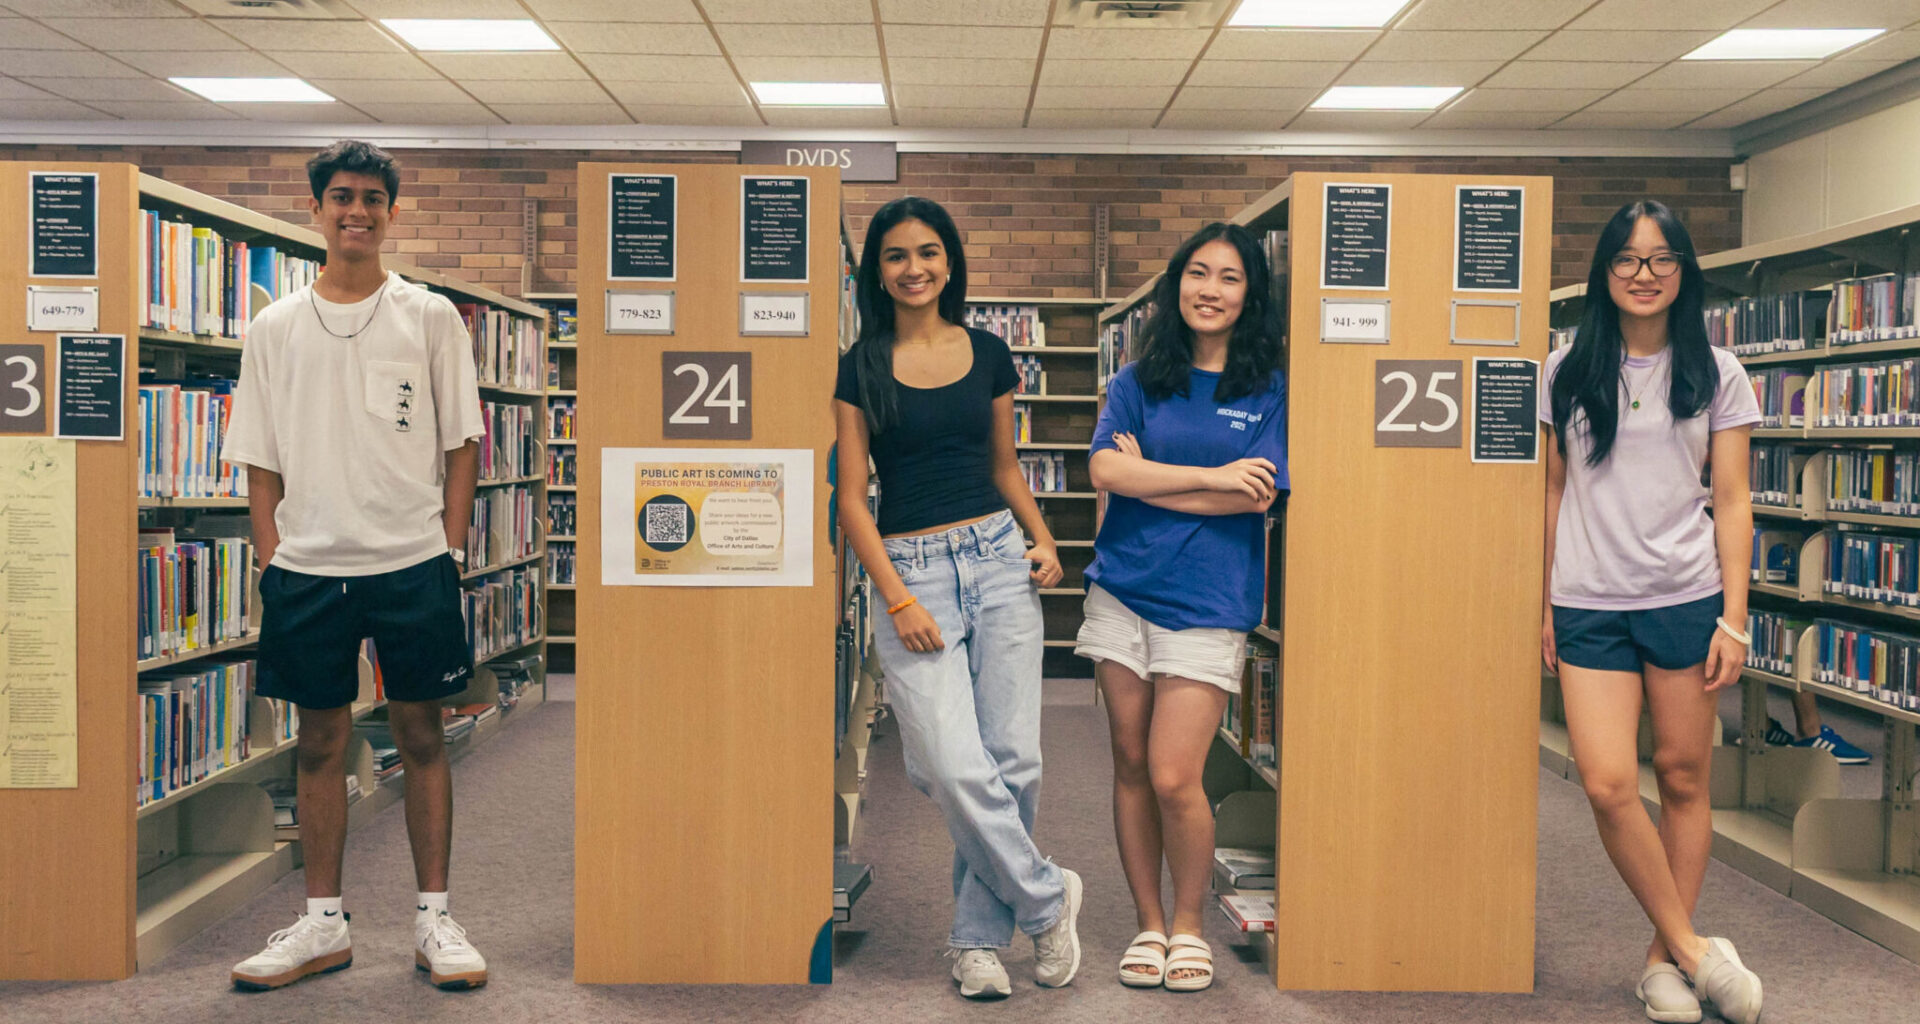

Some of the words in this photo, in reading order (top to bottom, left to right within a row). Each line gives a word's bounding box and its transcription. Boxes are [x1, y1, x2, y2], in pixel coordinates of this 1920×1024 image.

[786, 148, 852, 168] DVDS
[42, 306, 84, 316] 649-779
[620, 309, 662, 319] 779-823
[754, 311, 796, 321] 823-940
[1359, 318, 1377, 327] 999
[5, 355, 41, 417] 3
[669, 363, 746, 424] 24
[1377, 371, 1458, 432] 25
[641, 470, 679, 478] PUBLIC
[682, 470, 702, 478] ART
[718, 470, 761, 478] COMING
